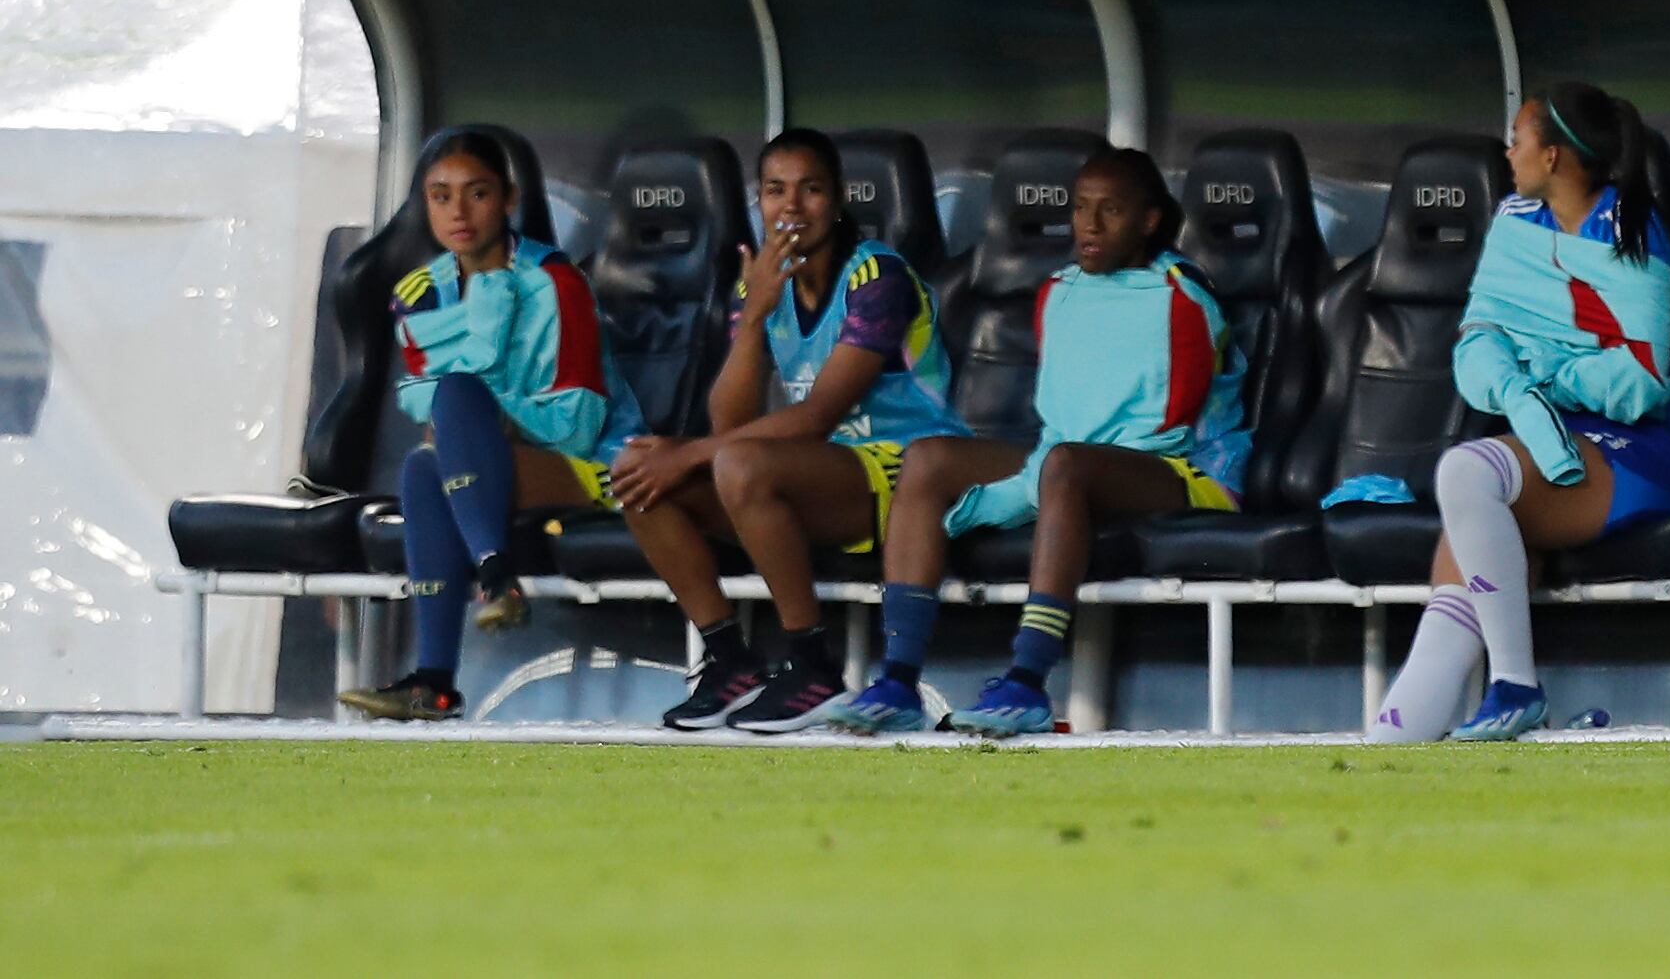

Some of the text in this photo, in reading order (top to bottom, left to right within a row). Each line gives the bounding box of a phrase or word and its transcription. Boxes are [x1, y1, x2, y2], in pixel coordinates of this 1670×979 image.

[635, 187, 686, 208] IDRD
[1018, 184, 1069, 206] IDRD
[1205, 183, 1256, 205] IDRD
[1415, 187, 1467, 208] IDRD
